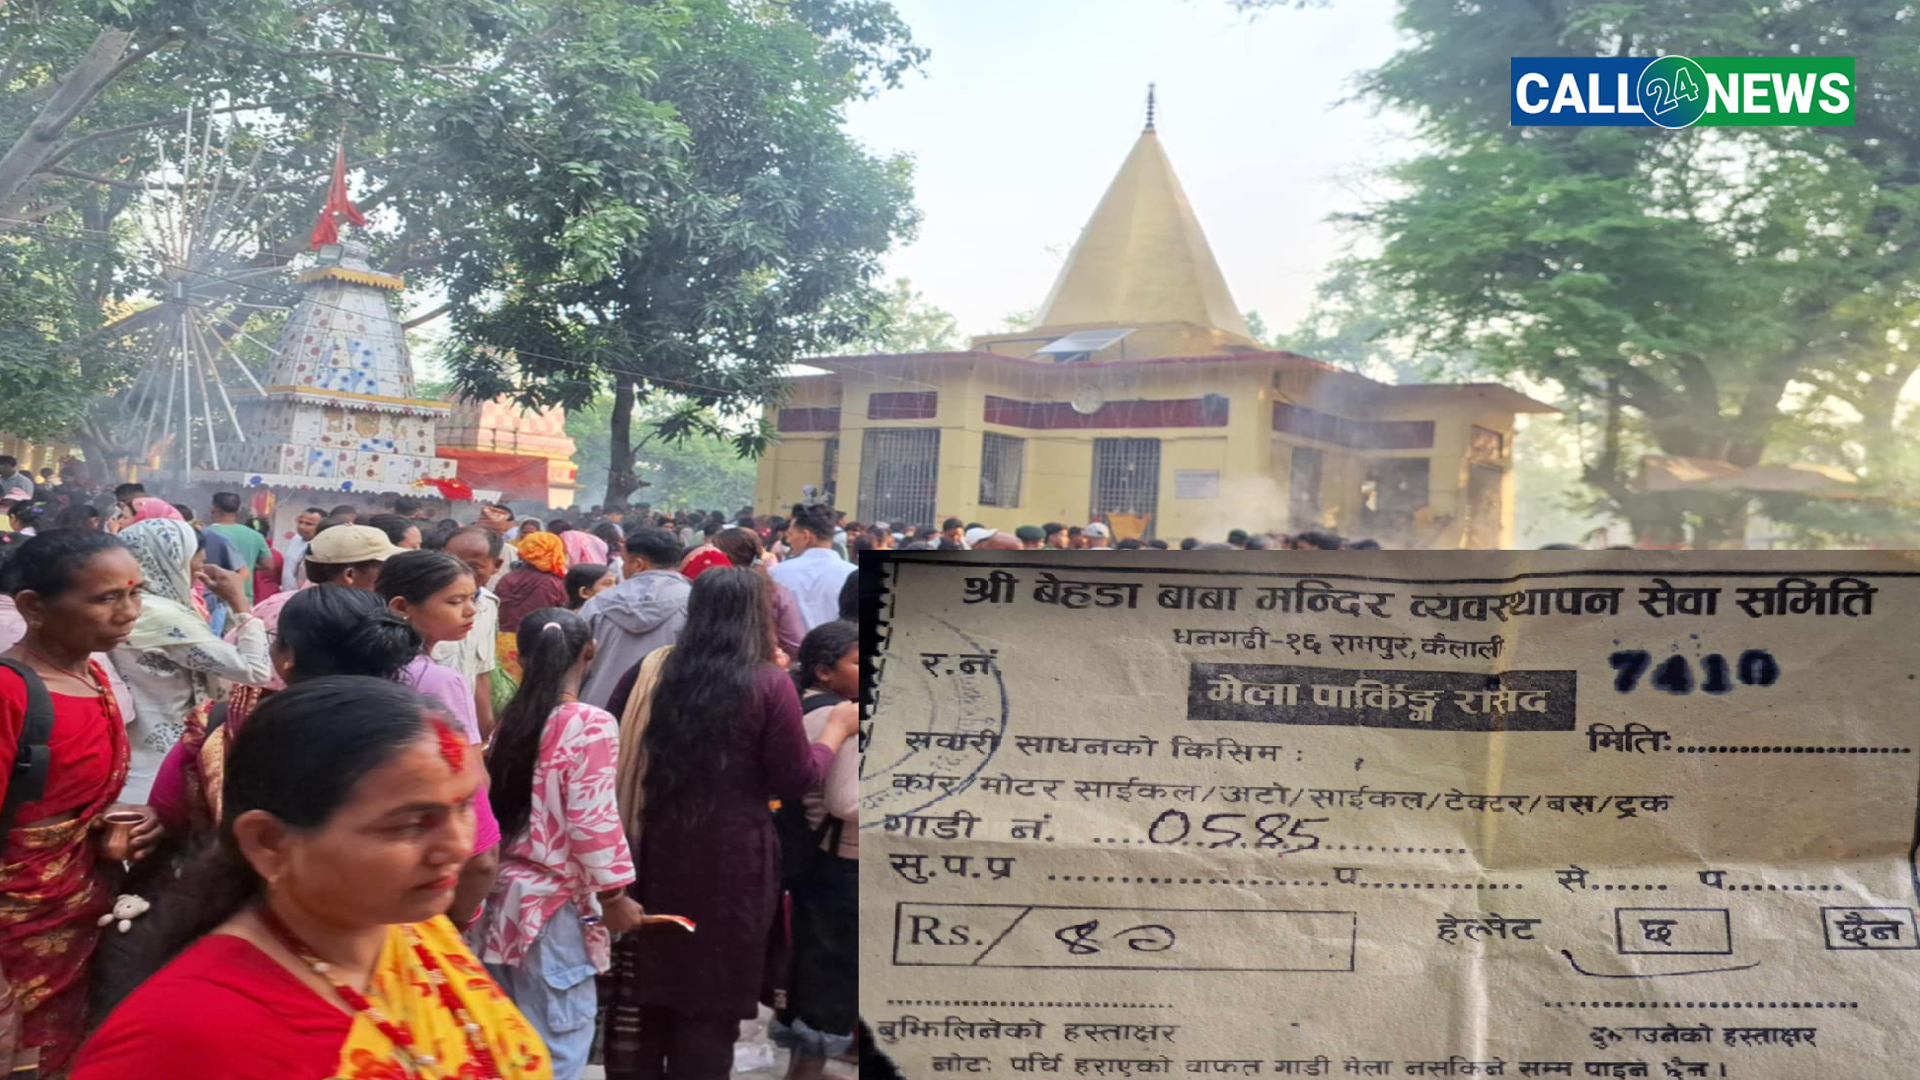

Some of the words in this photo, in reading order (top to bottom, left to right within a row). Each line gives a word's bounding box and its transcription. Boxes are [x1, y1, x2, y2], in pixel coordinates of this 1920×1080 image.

[963, 571, 1019, 605] श्री
[1033, 572, 1142, 610] बेहडा
[1159, 584, 1242, 612] बाबा
[1256, 579, 1396, 619] मन्दिर
[1410, 586, 1625, 622] व्यवस्थापन
[1638, 578, 1721, 618] सेवा
[1735, 578, 1878, 618] समिति
[1173, 627, 1322, 655] धनगढी-१६
[1607, 648, 1780, 695] 7410
[1206, 674, 1300, 706] मेला
[905, 729, 1001, 754] सवारी
[1015, 735, 1158, 757] साधनको
[1171, 736, 1282, 763] किसिम
[884, 810, 982, 838] गाडी
[1149, 809, 1330, 855] 0585
[906, 914, 983, 945] Rs.
[1639, 918, 1677, 946] छ
[1836, 911, 1902, 945] छैन
[1064, 1023, 1181, 1044] हस्ताक्षर
[1722, 1027, 1817, 1047] हस्ताक्षर
[1010, 1052, 1064, 1073] पर्चि
[1074, 1055, 1174, 1077] हराएको
[1274, 1054, 1331, 1077] गाडी
[1343, 1056, 1393, 1075] मेला
[1404, 1055, 1506, 1077] नसकिने
[1519, 1061, 1578, 1078] सम्म
